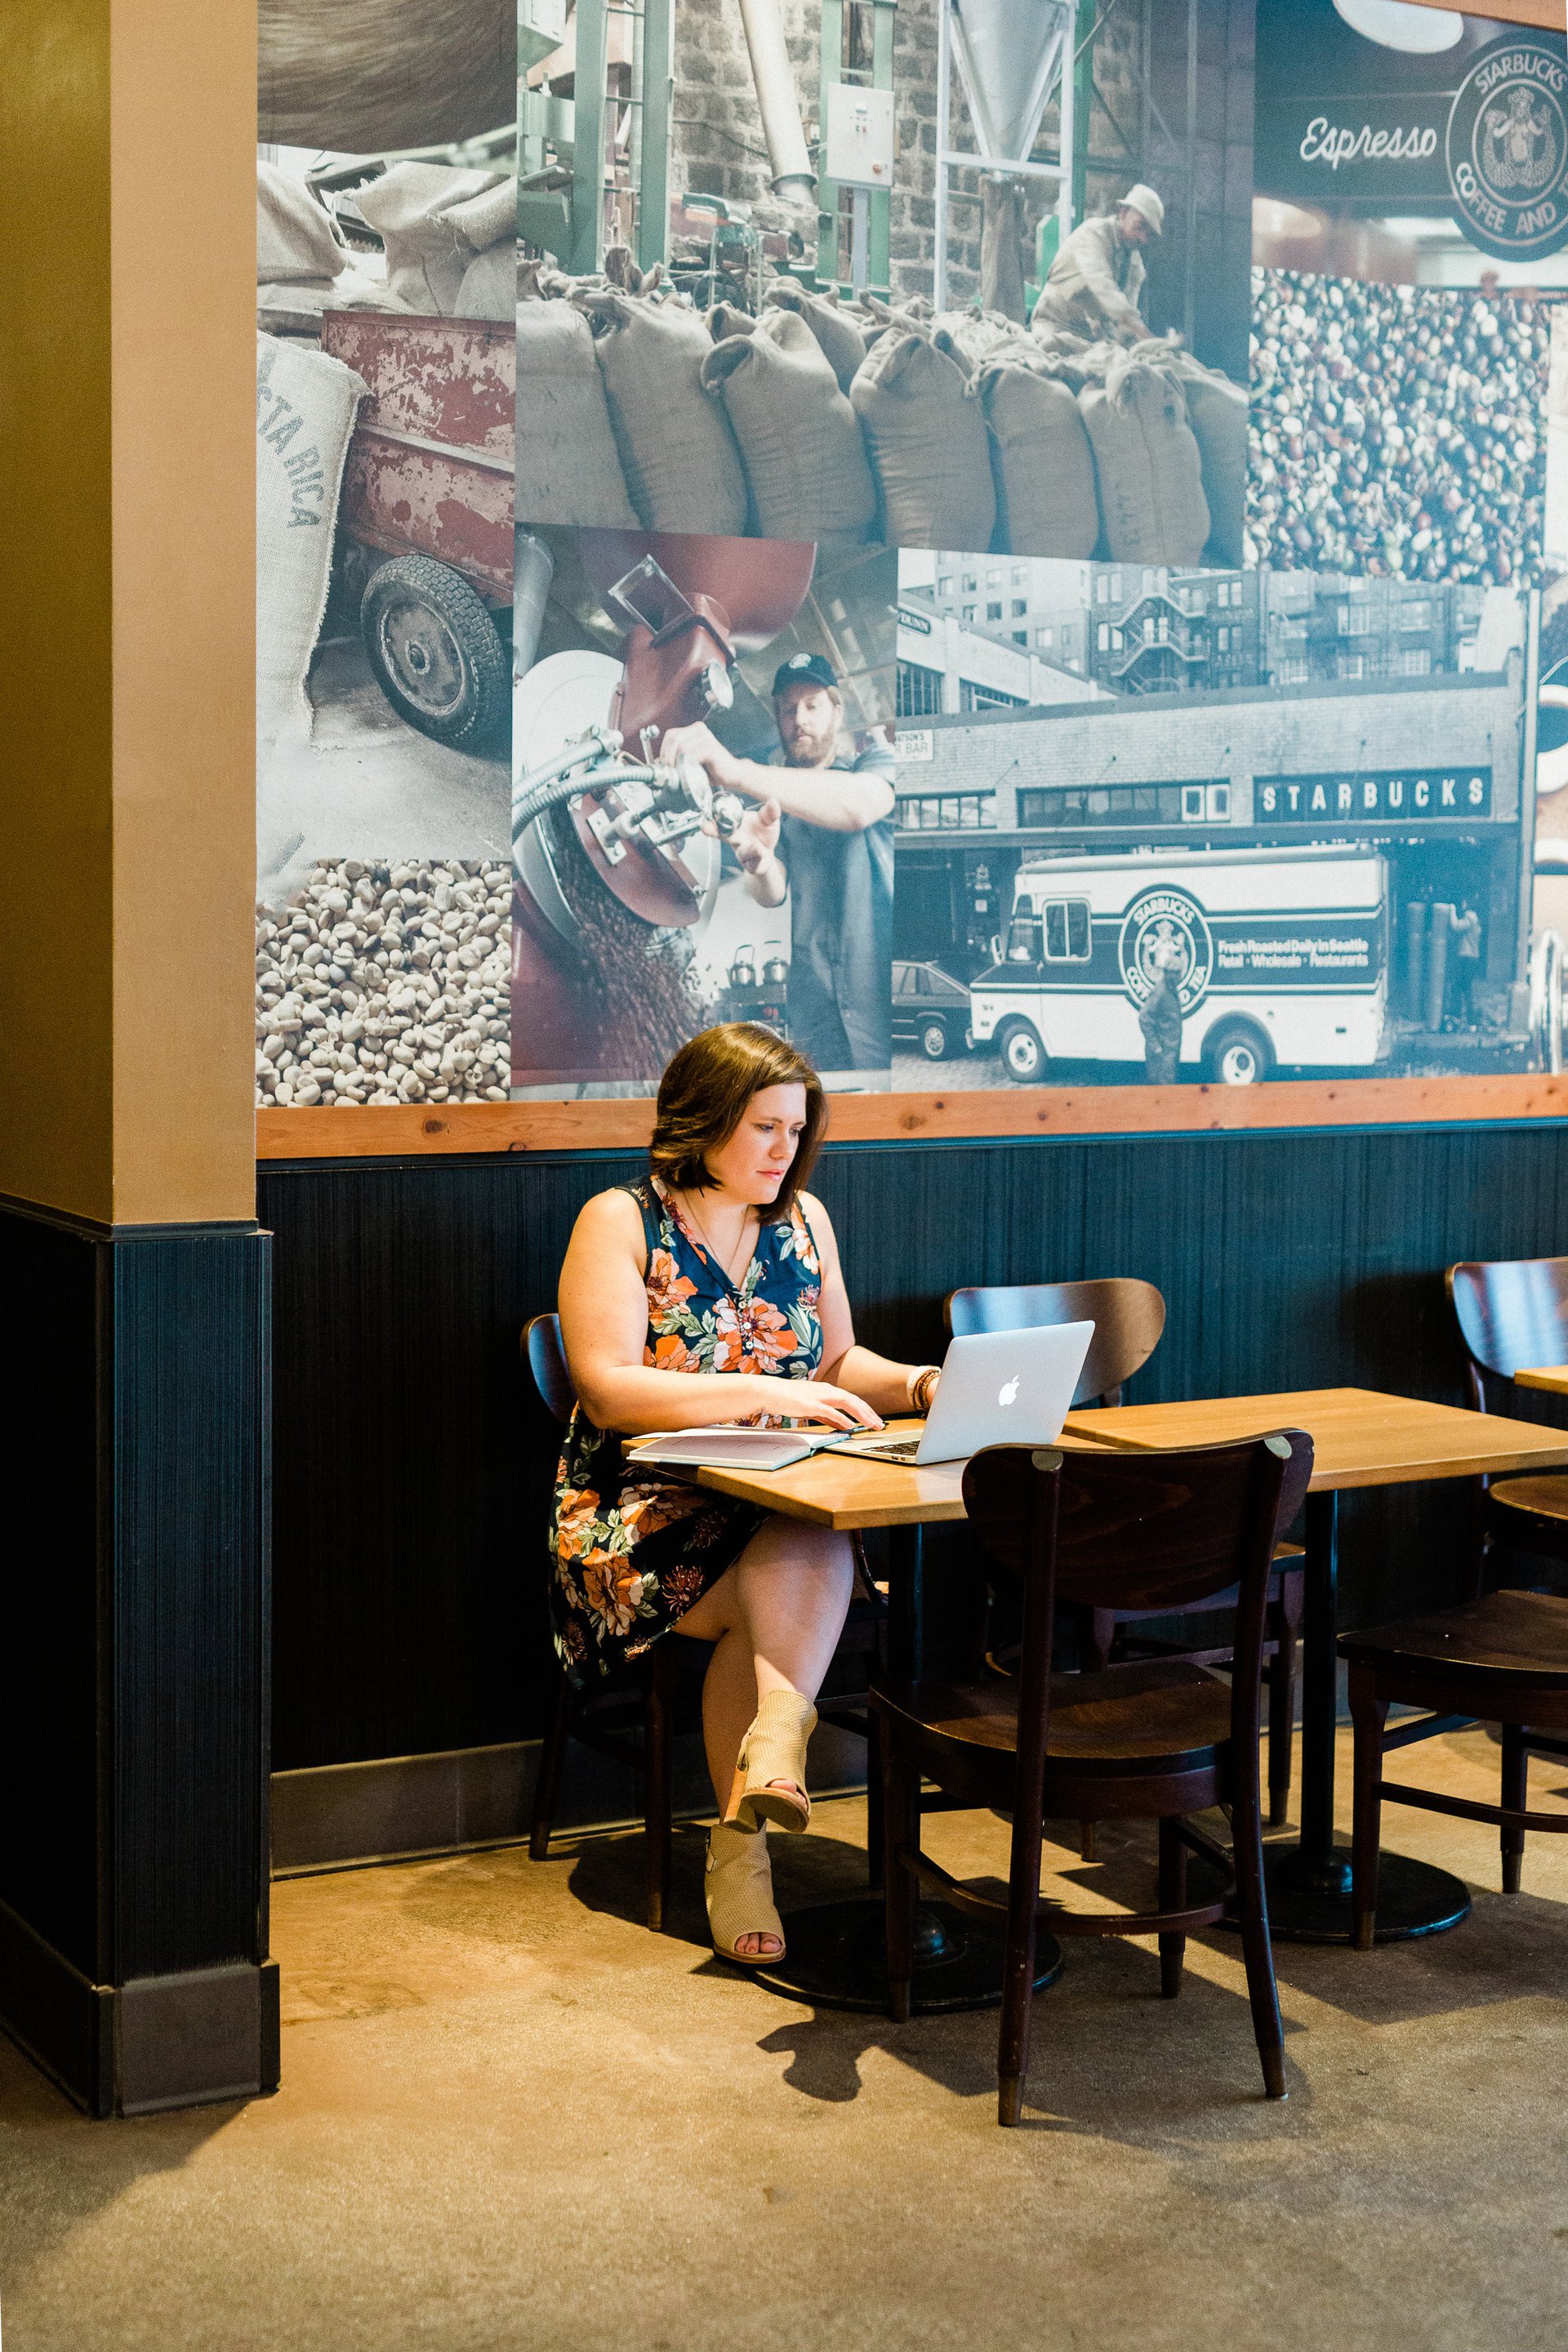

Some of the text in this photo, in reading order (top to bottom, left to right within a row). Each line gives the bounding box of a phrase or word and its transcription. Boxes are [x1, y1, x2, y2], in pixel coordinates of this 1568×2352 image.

[1474, 53, 1568, 95] STARBUCKS
[1300, 117, 1437, 170] Espresso
[1455, 163, 1506, 234] COFFEE
[1517, 201, 1557, 235] AND
[283, 445, 326, 528] RICA
[1263, 778, 1484, 812] STARBUCKS
[1133, 898, 1196, 926] STARBUCKS
[1188, 966, 1207, 991] TEA
